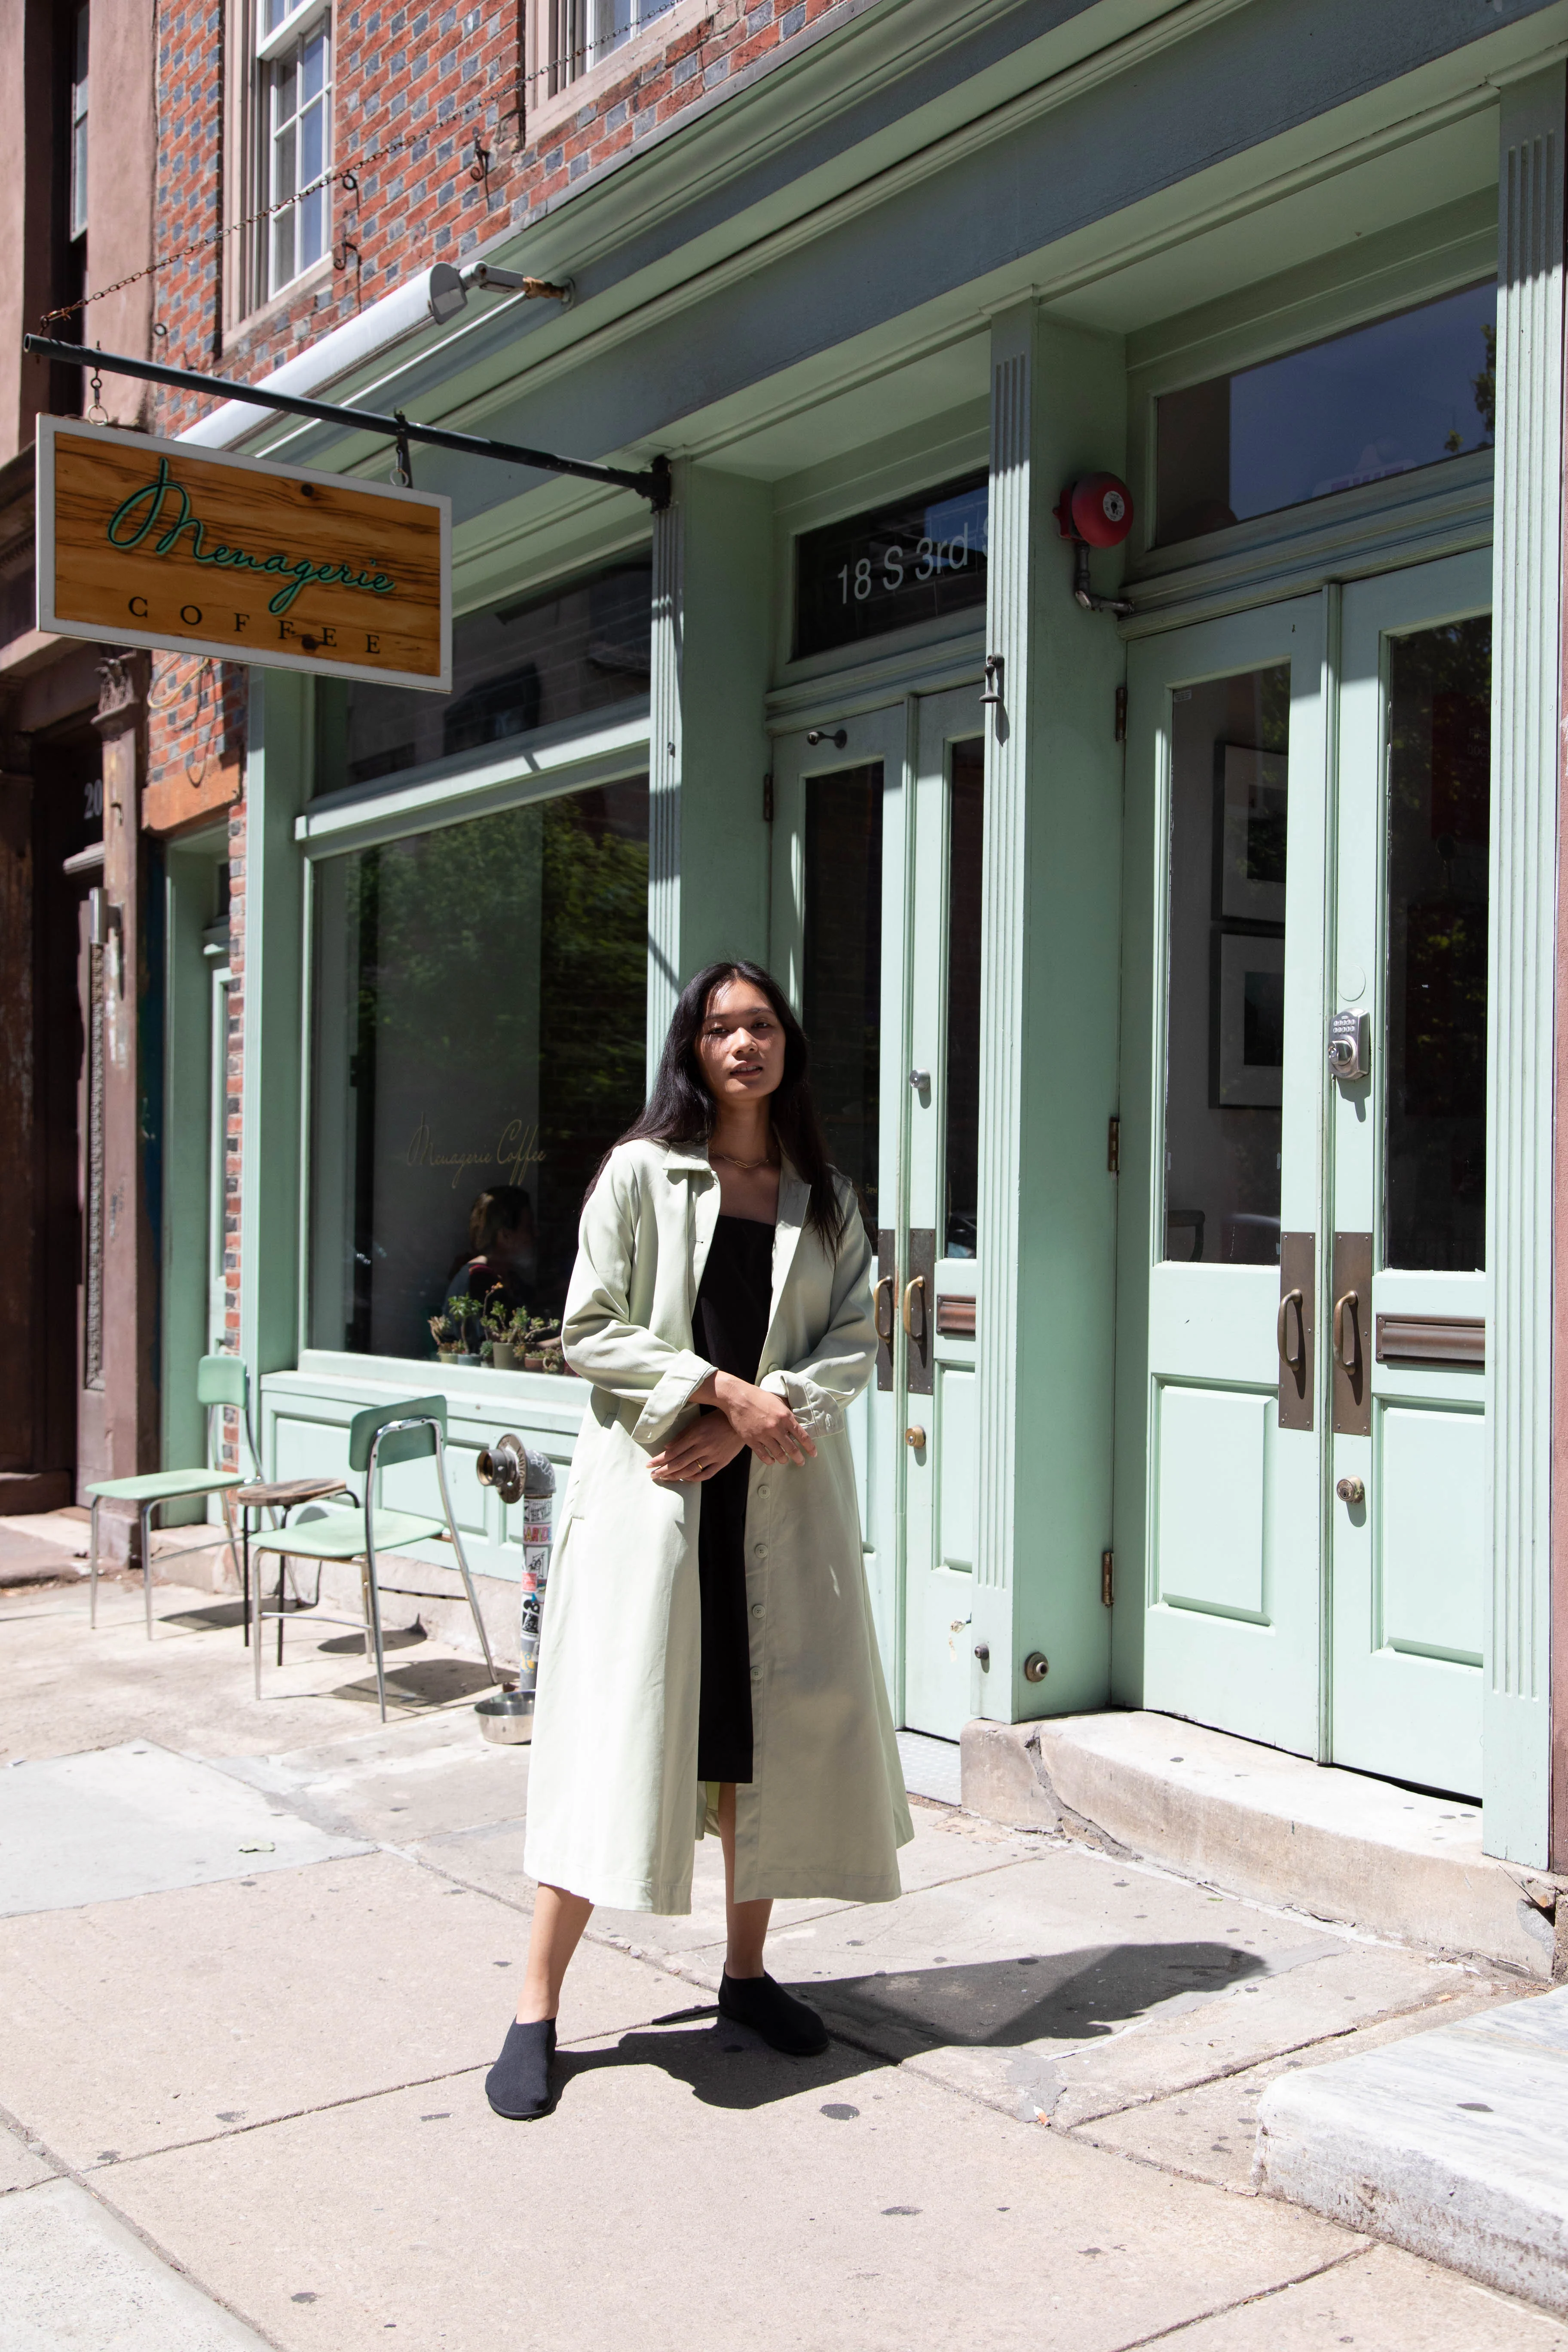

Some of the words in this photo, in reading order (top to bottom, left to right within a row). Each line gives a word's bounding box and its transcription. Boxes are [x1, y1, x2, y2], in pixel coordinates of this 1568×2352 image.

[107, 457, 395, 616] Menagerie
[838, 558, 871, 604] 18
[883, 545, 903, 590] S
[915, 522, 968, 580] 3rd
[128, 596, 381, 654] COFFEE
[83, 779, 102, 819] 20
[407, 1111, 493, 1189] Menagerie
[497, 1119, 548, 1186] Coffee
